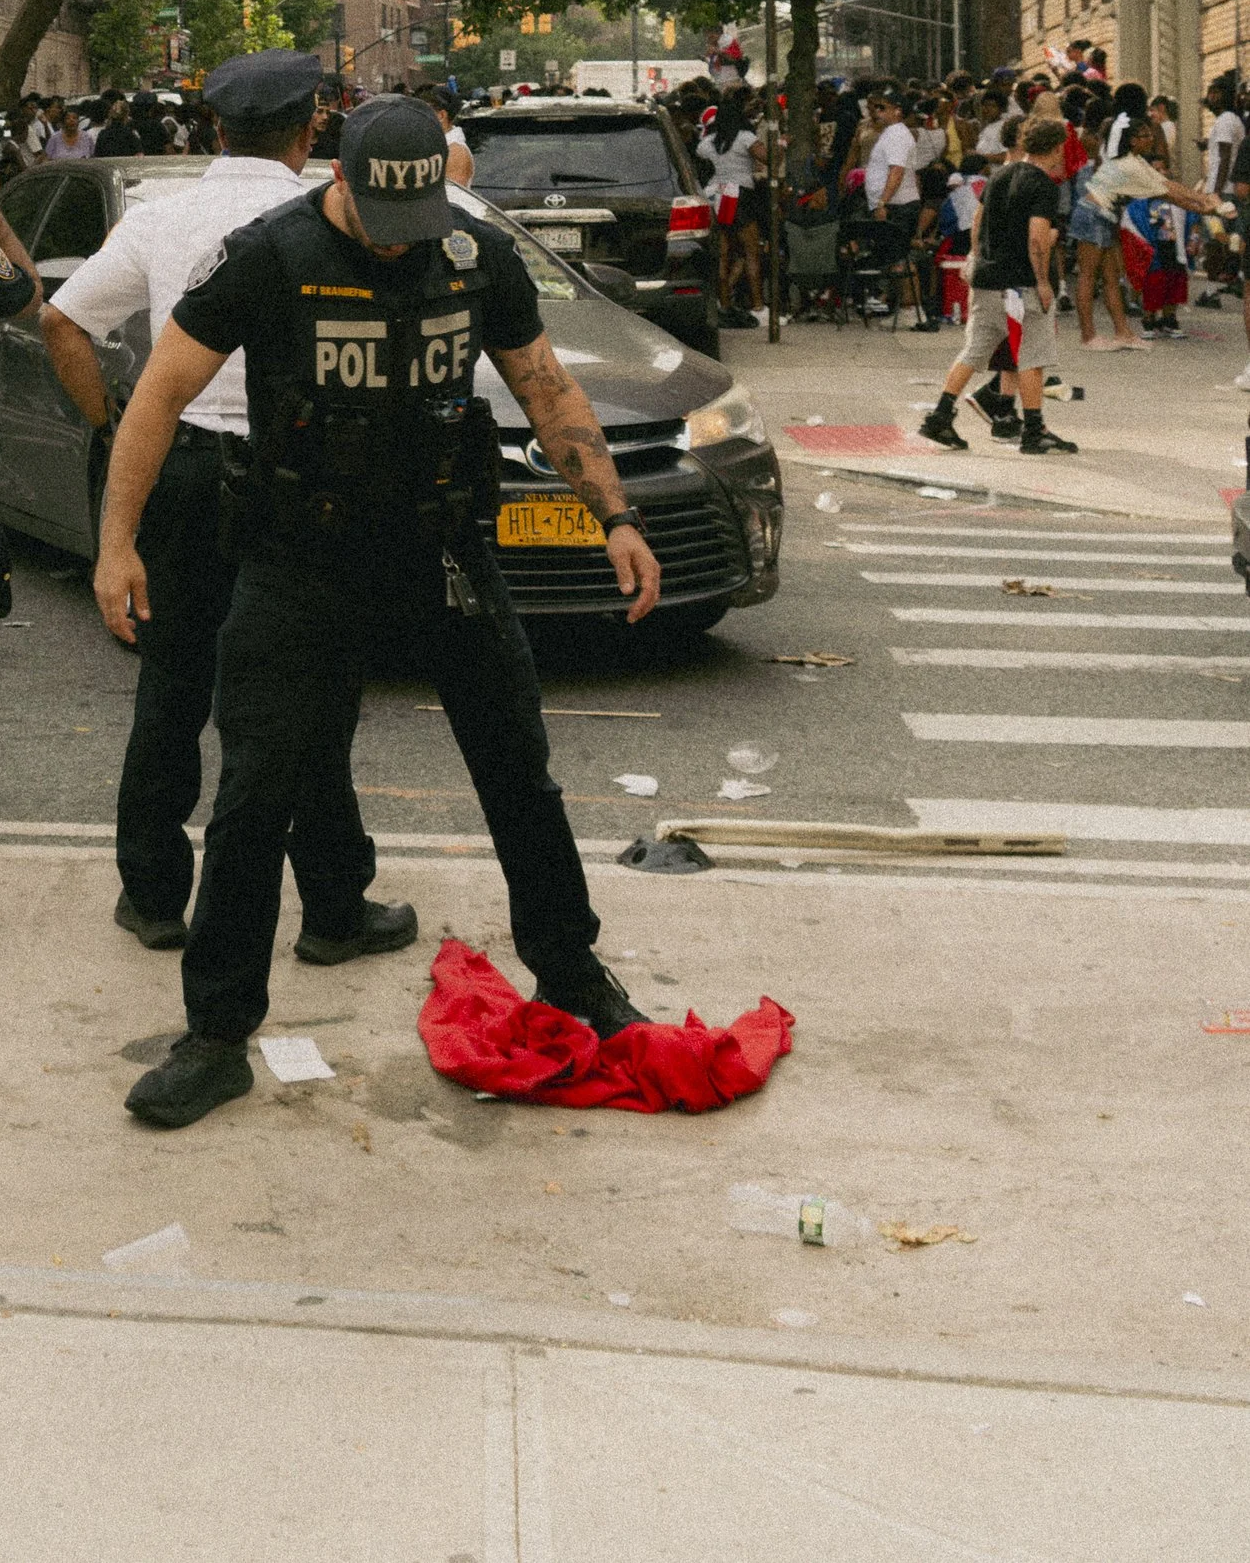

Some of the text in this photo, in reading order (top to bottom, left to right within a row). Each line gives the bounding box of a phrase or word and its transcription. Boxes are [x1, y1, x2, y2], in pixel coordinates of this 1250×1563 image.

[368, 153, 443, 190] NYPD
[525, 493, 579, 502] NEW YORK
